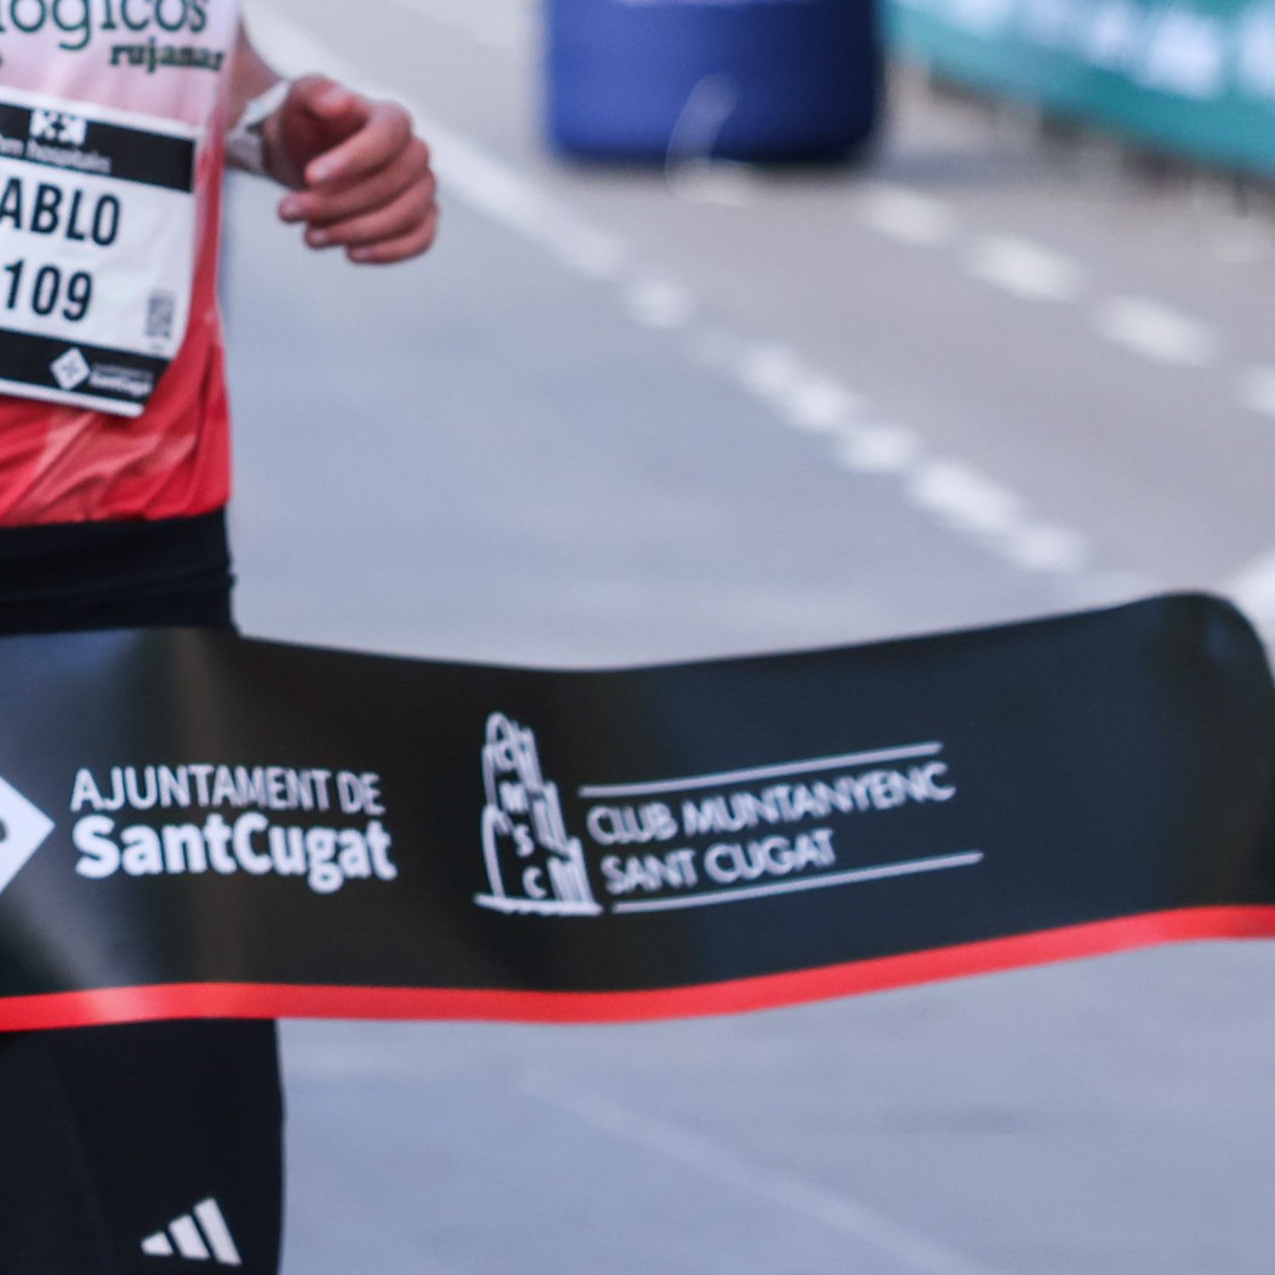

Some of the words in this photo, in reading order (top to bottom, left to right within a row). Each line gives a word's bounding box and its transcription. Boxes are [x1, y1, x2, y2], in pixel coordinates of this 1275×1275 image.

[70, 764, 331, 812] AJUNTAMENT
[338, 772, 386, 815] DE
[585, 801, 679, 846] CLUB
[682, 762, 957, 838] MUNTANYENC
[70, 813, 399, 894] SantCugat
[599, 847, 697, 895] SANT
[703, 827, 838, 885] CUGAT
